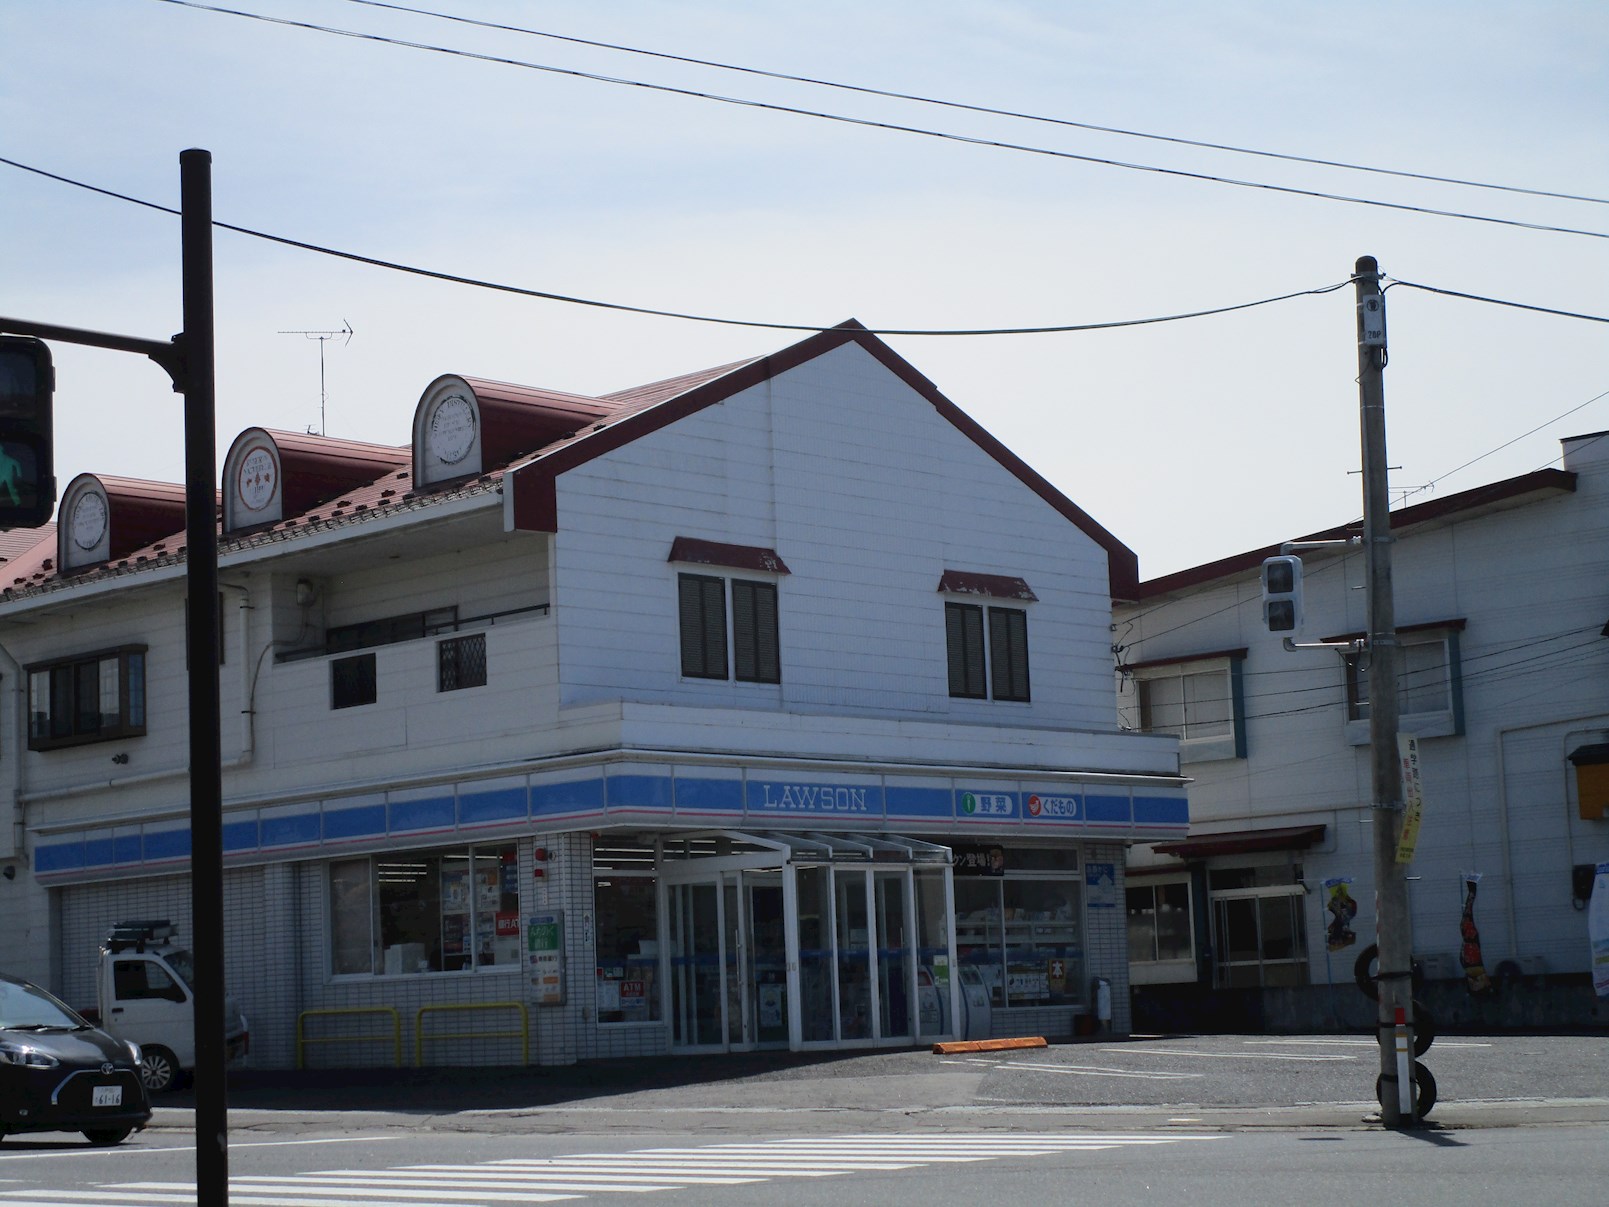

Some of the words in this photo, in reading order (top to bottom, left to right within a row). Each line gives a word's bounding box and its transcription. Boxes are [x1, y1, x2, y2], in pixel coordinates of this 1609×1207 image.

[763, 785, 867, 810] LAWSON
[979, 796, 1005, 813] 野菜
[1043, 799, 1075, 815] くだもの
[623, 983, 641, 992] ATM
